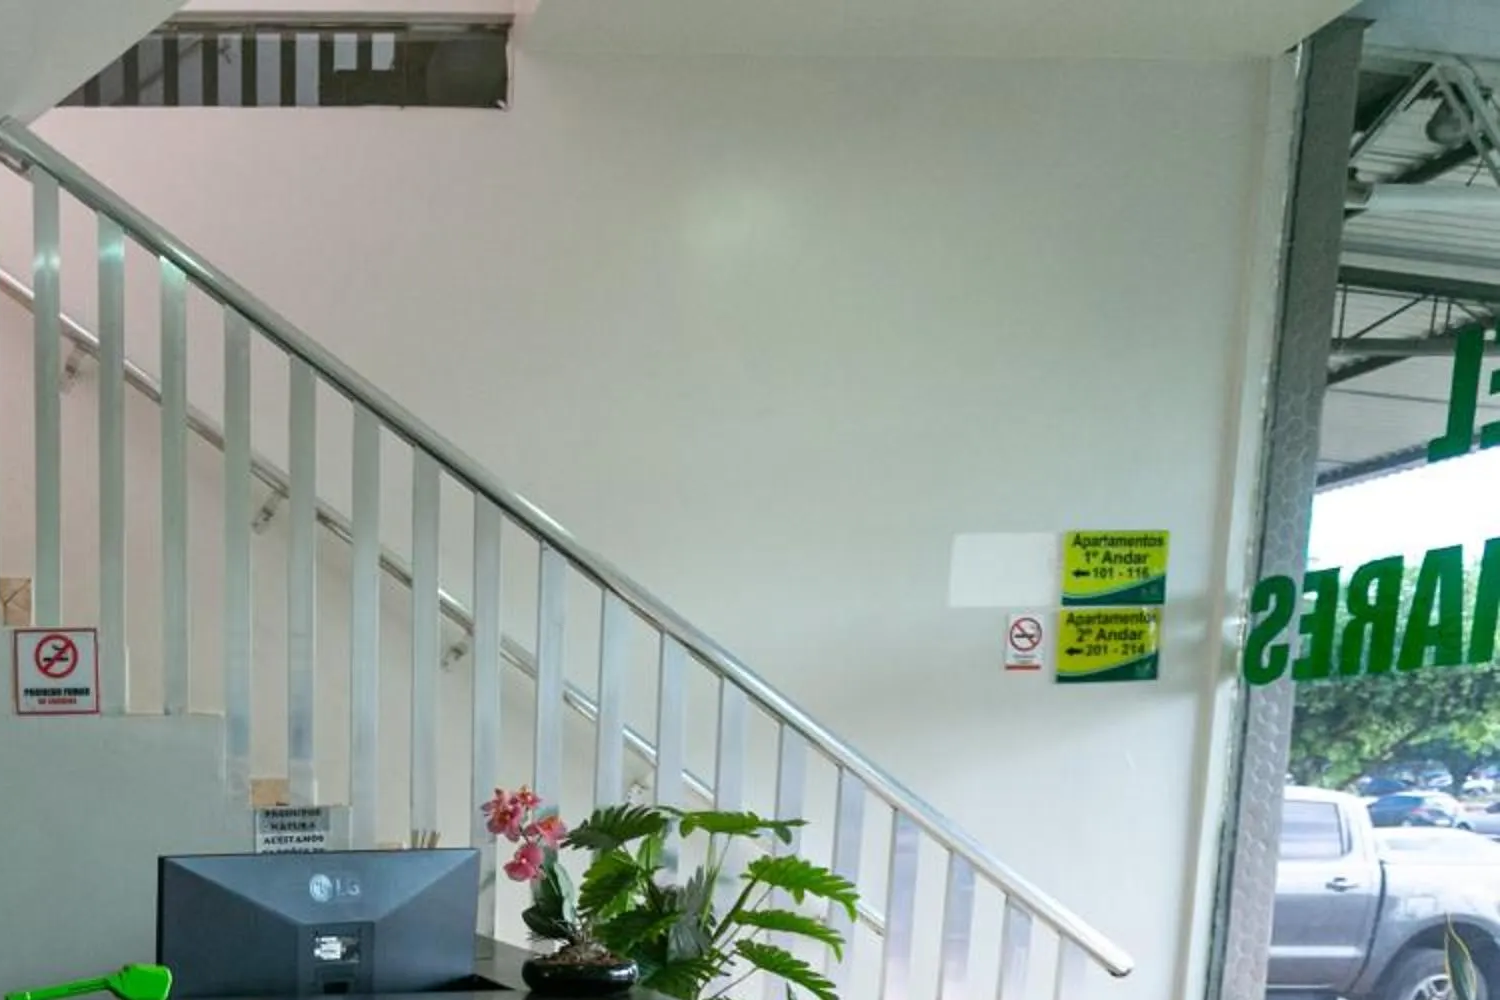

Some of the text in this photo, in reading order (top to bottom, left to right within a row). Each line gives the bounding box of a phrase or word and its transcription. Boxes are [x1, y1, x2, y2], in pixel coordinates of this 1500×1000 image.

[1072, 533, 1165, 549] Apartamentos
[1101, 550, 1150, 565] Andar
[1092, 567, 1113, 578] 101
[1095, 627, 1145, 641] Andar
[263, 834, 325, 845] ACEITAMOS
